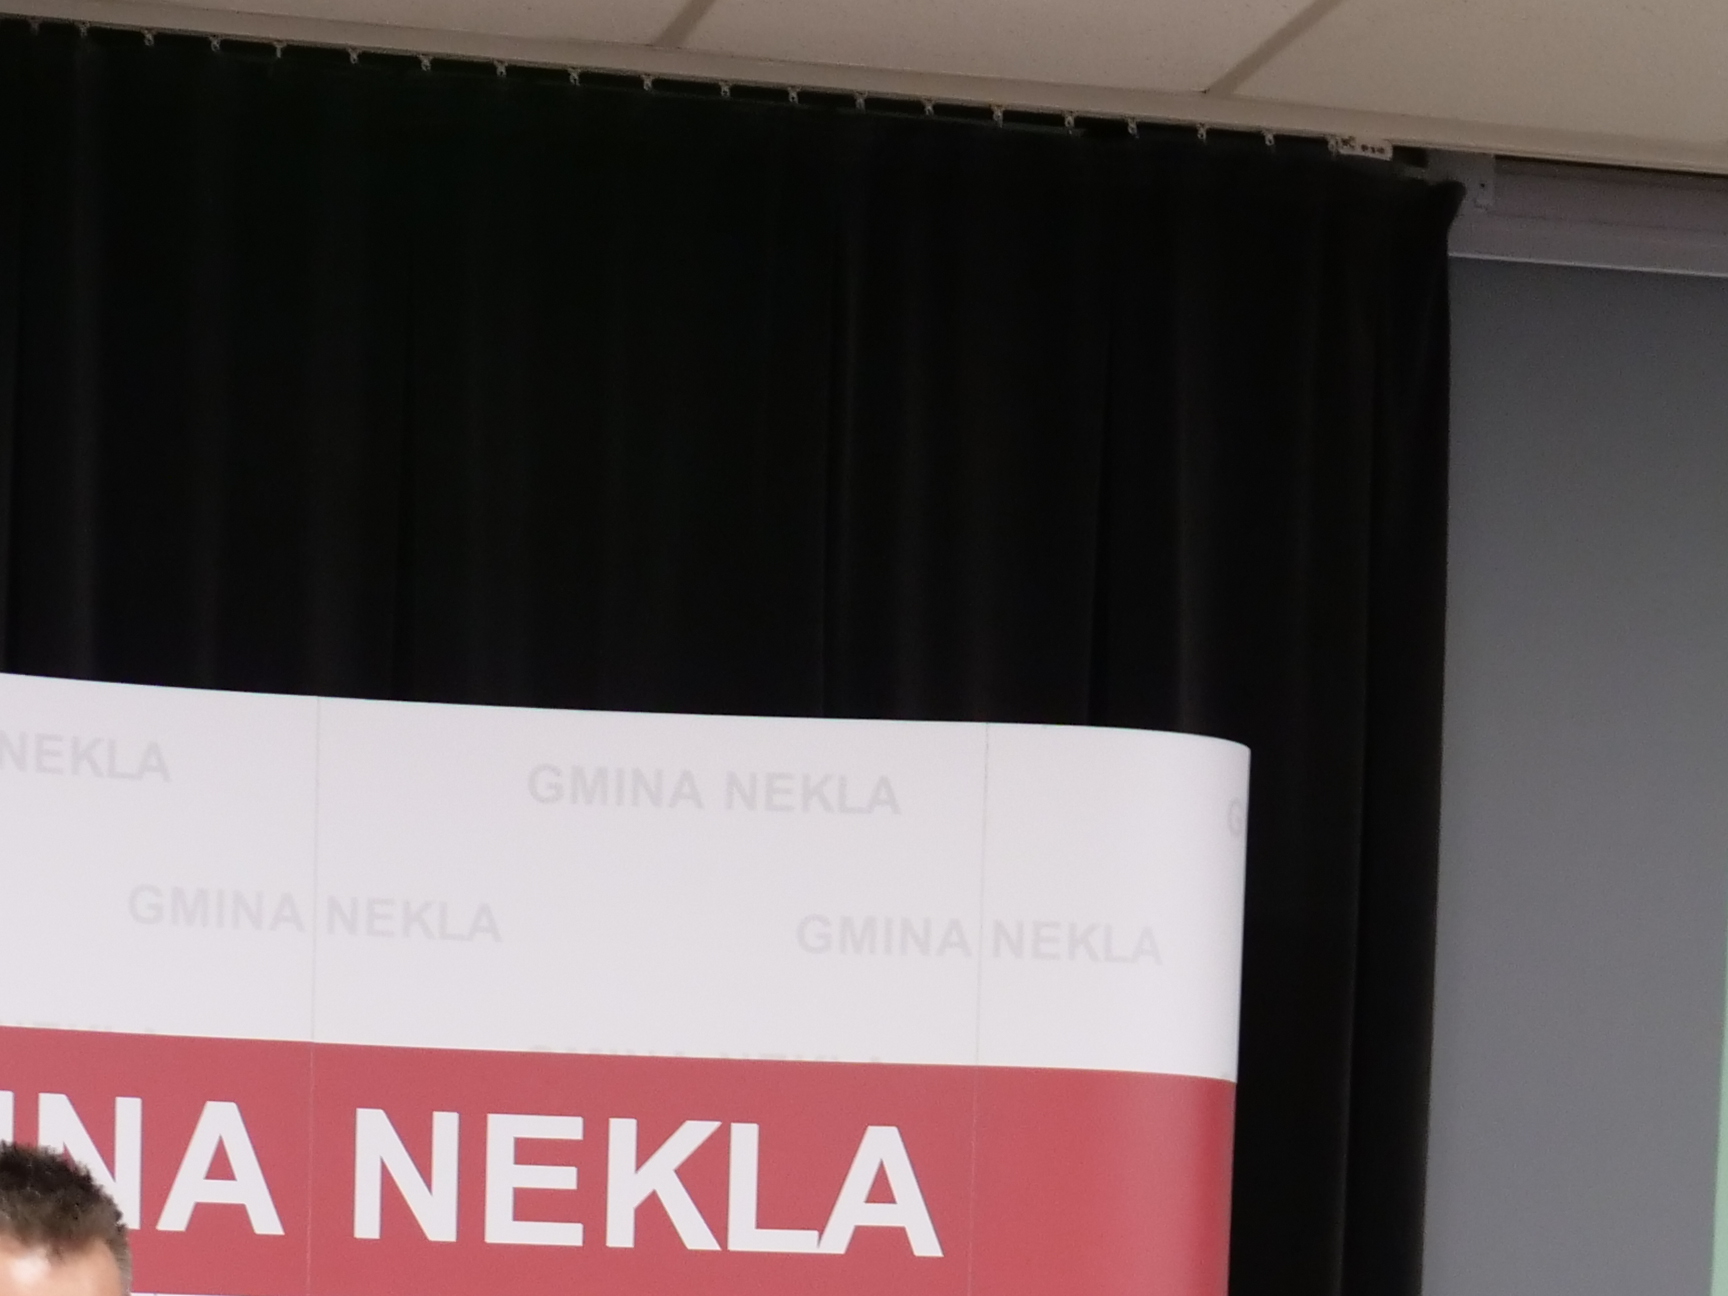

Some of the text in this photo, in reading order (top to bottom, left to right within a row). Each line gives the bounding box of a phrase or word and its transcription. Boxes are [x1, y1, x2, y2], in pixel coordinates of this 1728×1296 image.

[527, 763, 901, 815] GMINA NEKLA
[128, 884, 502, 943] GMINA NEKLA
[796, 913, 1163, 966] GMINA NEKLA
[353, 1107, 944, 1257] NEKLA
